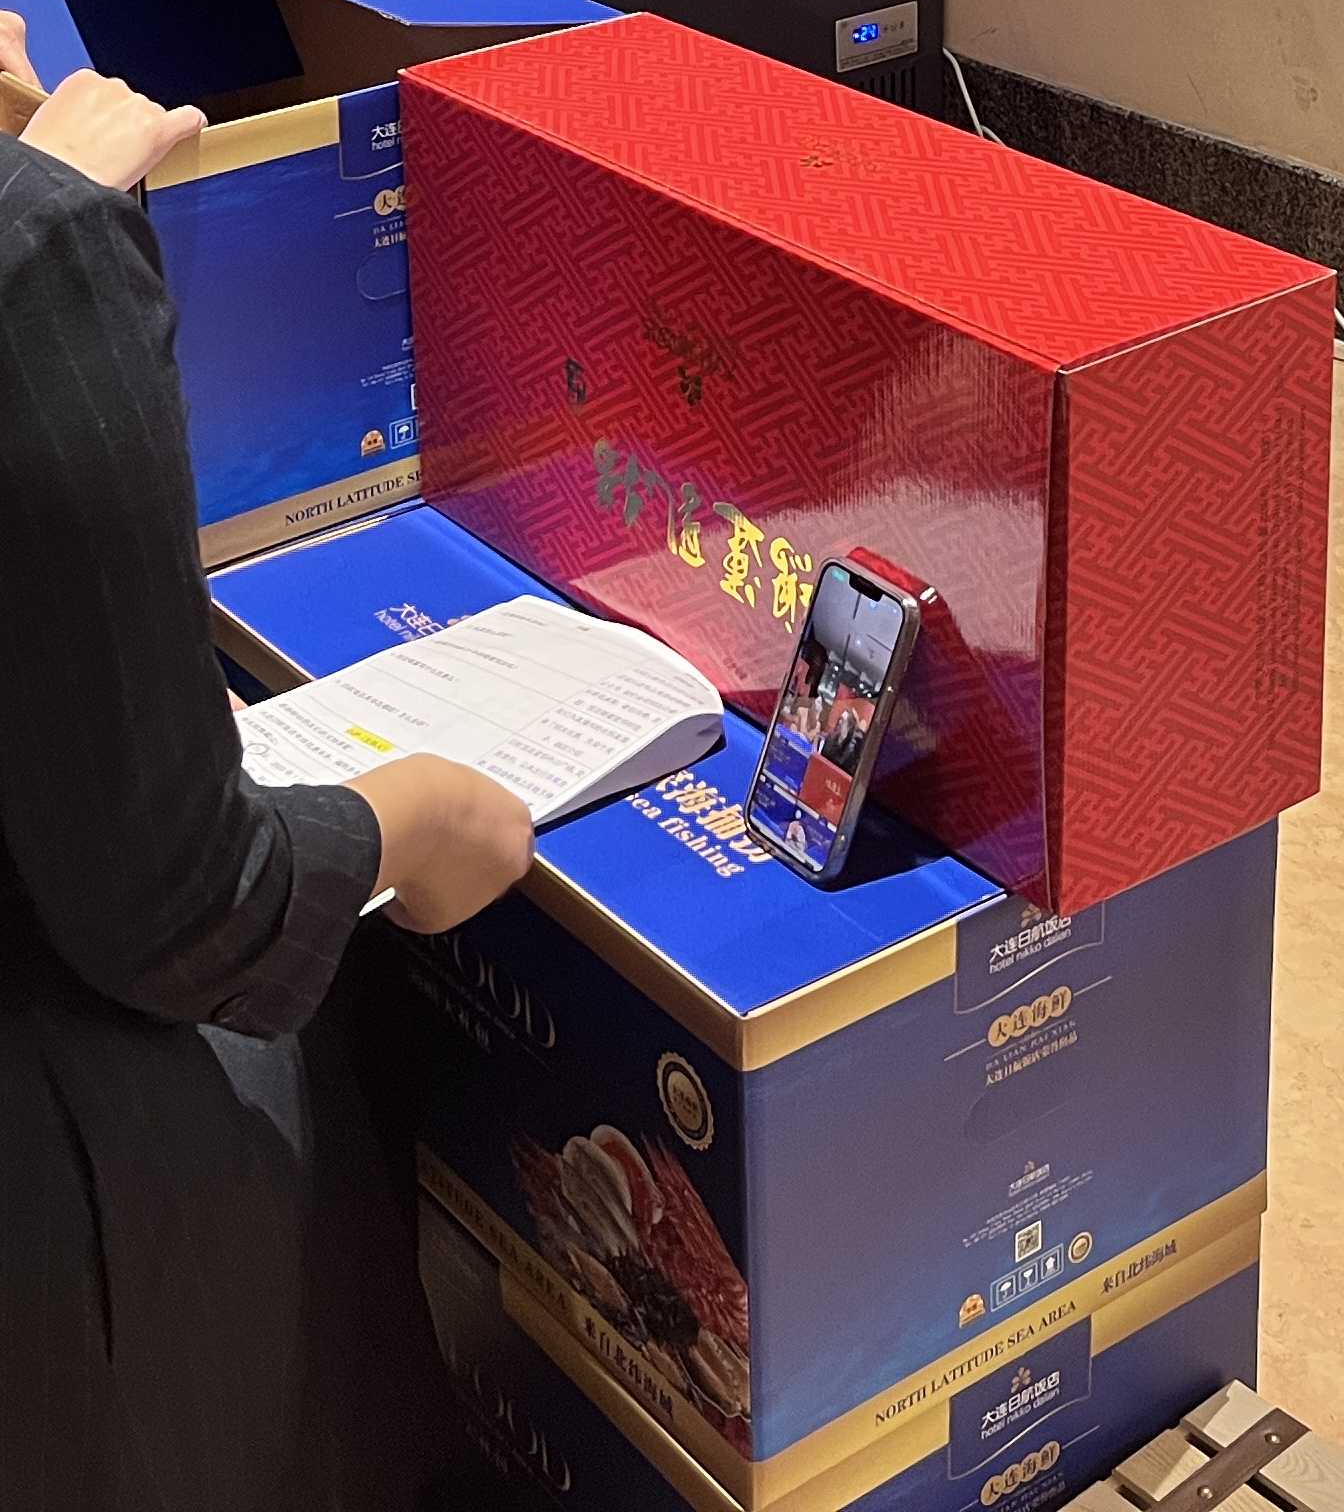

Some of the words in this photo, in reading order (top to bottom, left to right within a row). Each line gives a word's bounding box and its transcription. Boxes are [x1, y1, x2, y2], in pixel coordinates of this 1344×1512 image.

[285, 501, 335, 526] NORTH
[336, 475, 405, 512] LATITUDE
[657, 817, 745, 878] fishing
[875, 1386, 927, 1427] NORTH
[931, 1340, 1005, 1394] LATITUDE
[1007, 1323, 1035, 1347] SEA
[1038, 1300, 1077, 1333] AREA
[980, 1370, 1060, 1430] 大连日航饭店
